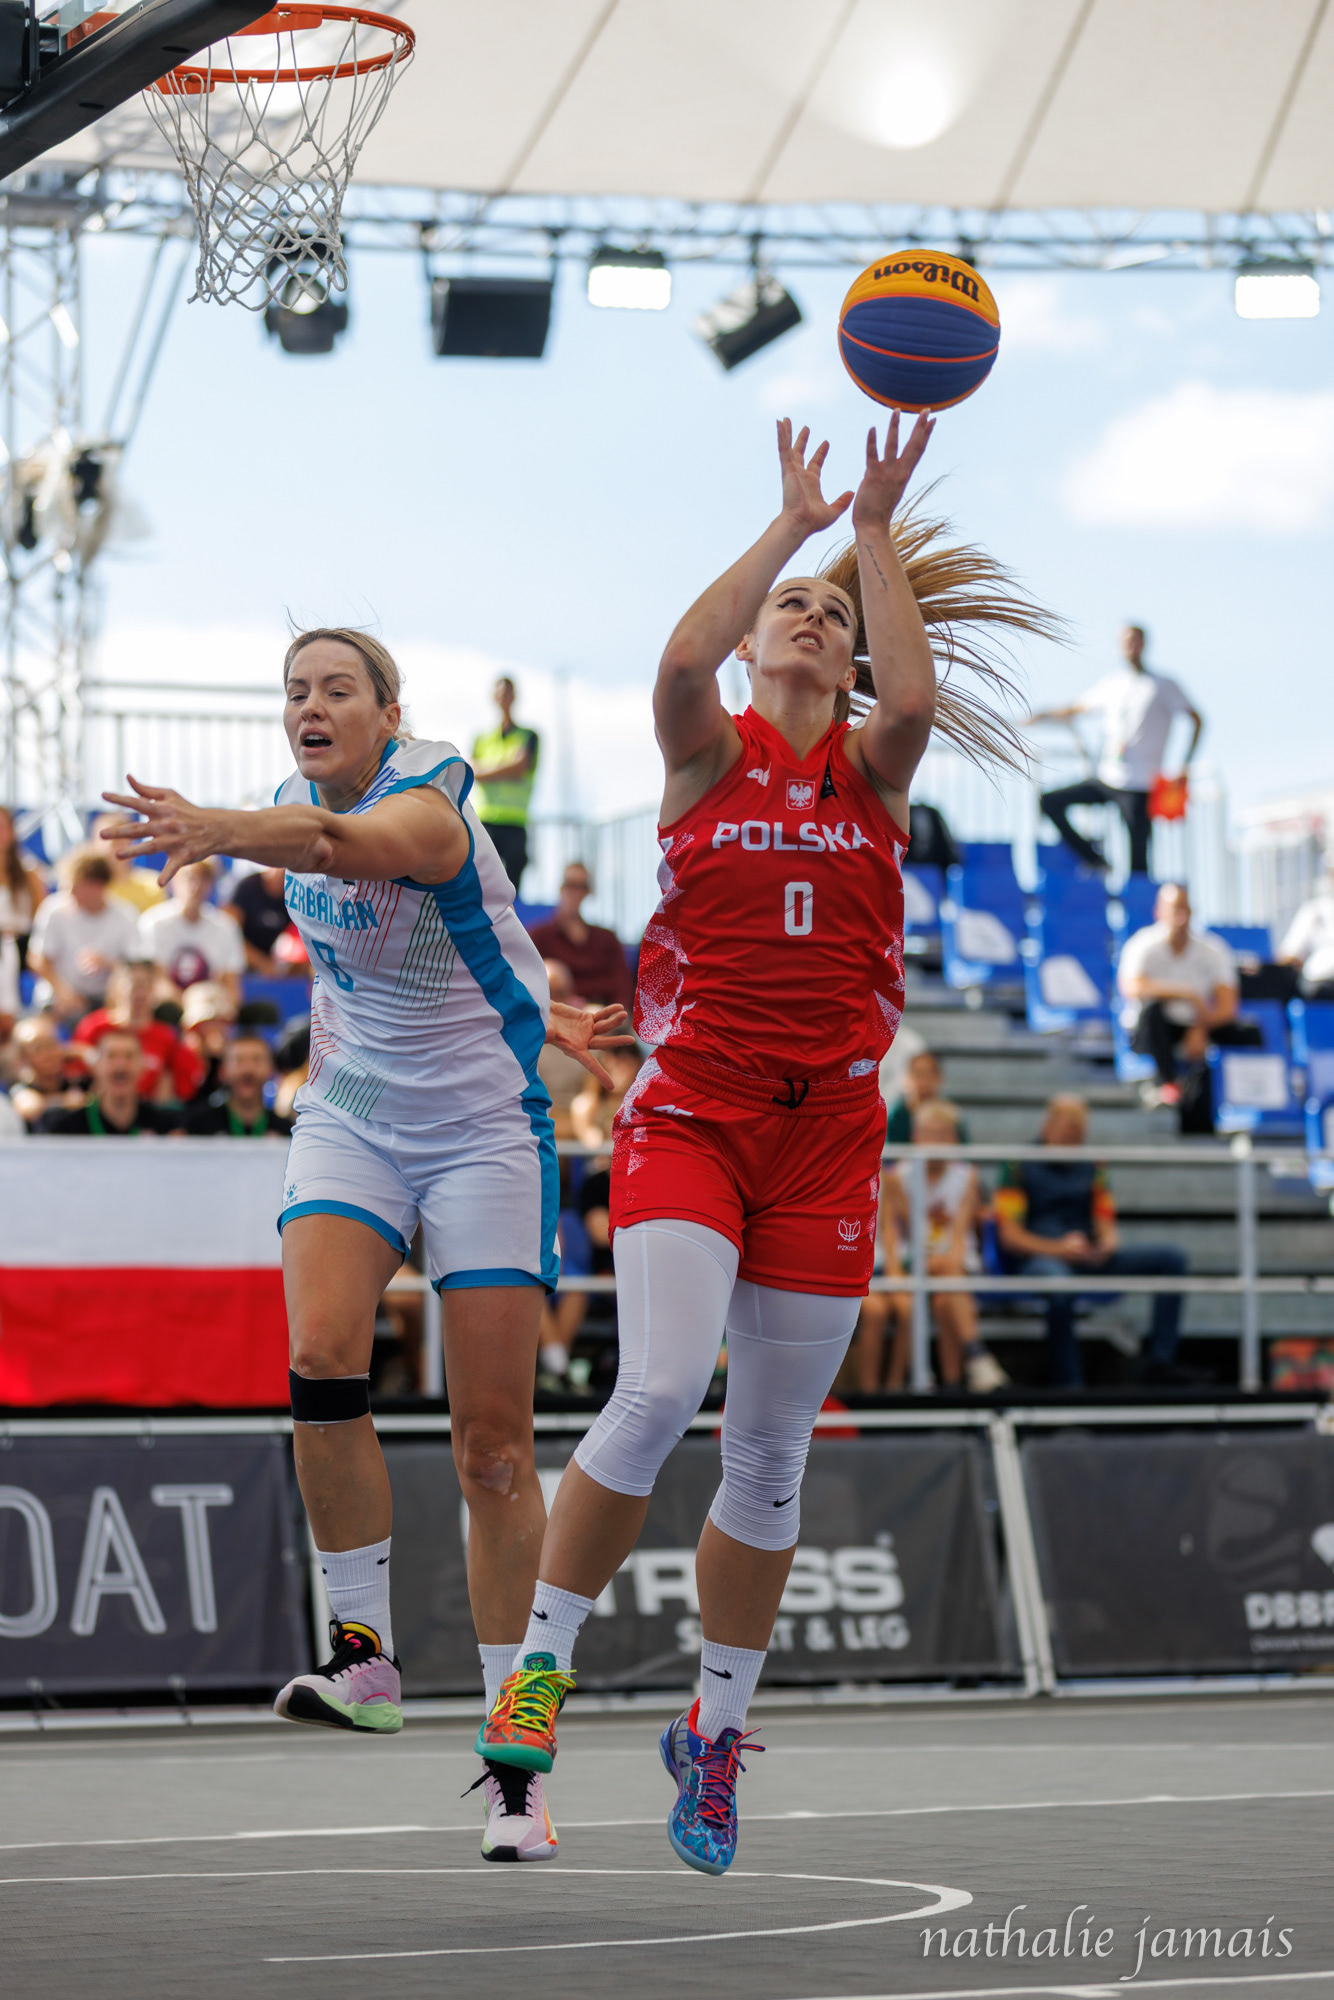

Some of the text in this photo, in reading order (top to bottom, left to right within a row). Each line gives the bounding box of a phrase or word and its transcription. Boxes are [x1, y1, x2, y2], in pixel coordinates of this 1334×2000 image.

[873, 261, 980, 303] Wilson
[711, 820, 875, 853] POLSKA
[784, 881, 814, 936] 0
